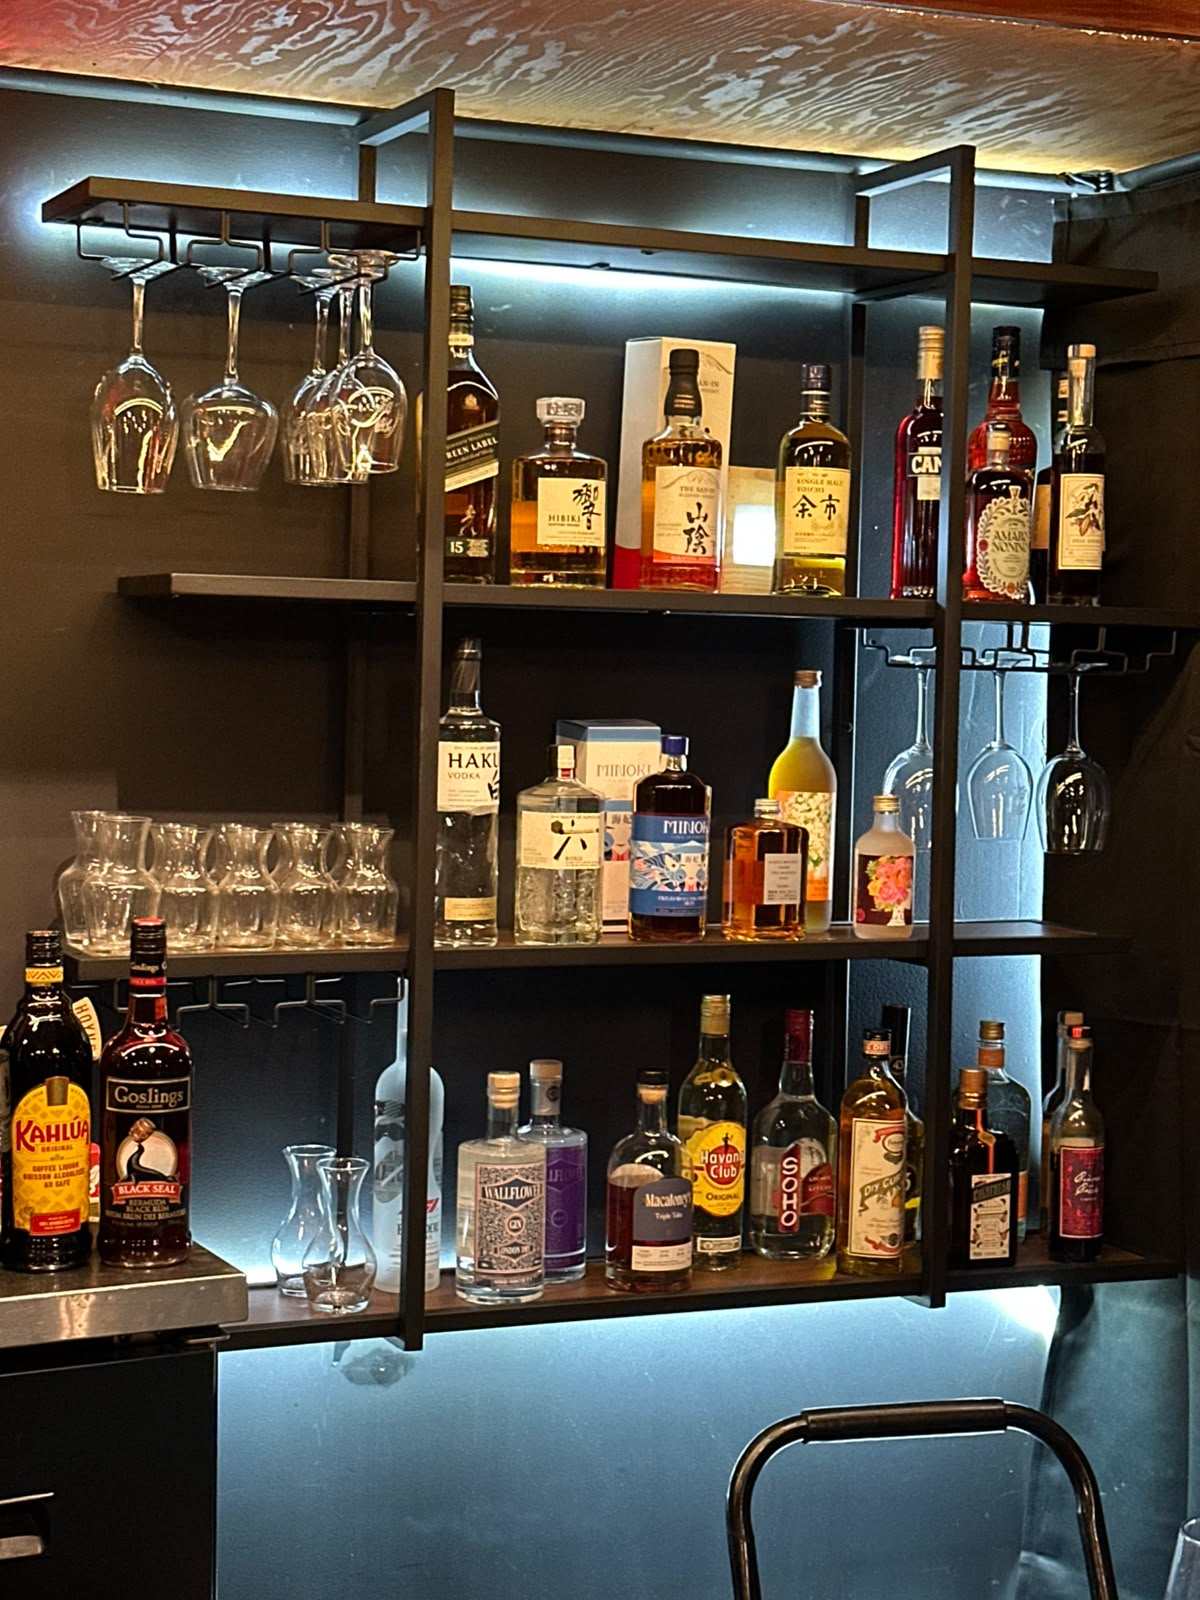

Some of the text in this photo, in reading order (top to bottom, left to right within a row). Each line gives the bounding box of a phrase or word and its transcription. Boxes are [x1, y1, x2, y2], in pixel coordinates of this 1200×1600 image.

[446, 446, 469, 459] REEN
[470, 436, 498, 451] LABEL
[792, 493, 841, 521] 余市
[450, 541, 463, 554] 15
[596, 764, 651, 777] MINOKI
[114, 1085, 184, 1108] Goslings
[15, 1116, 89, 1152] KAHLÚA
[710, 1165, 737, 1178] Club
[118, 1185, 175, 1194] BLACK SEAL
[780, 1157, 798, 1227] SOHO
